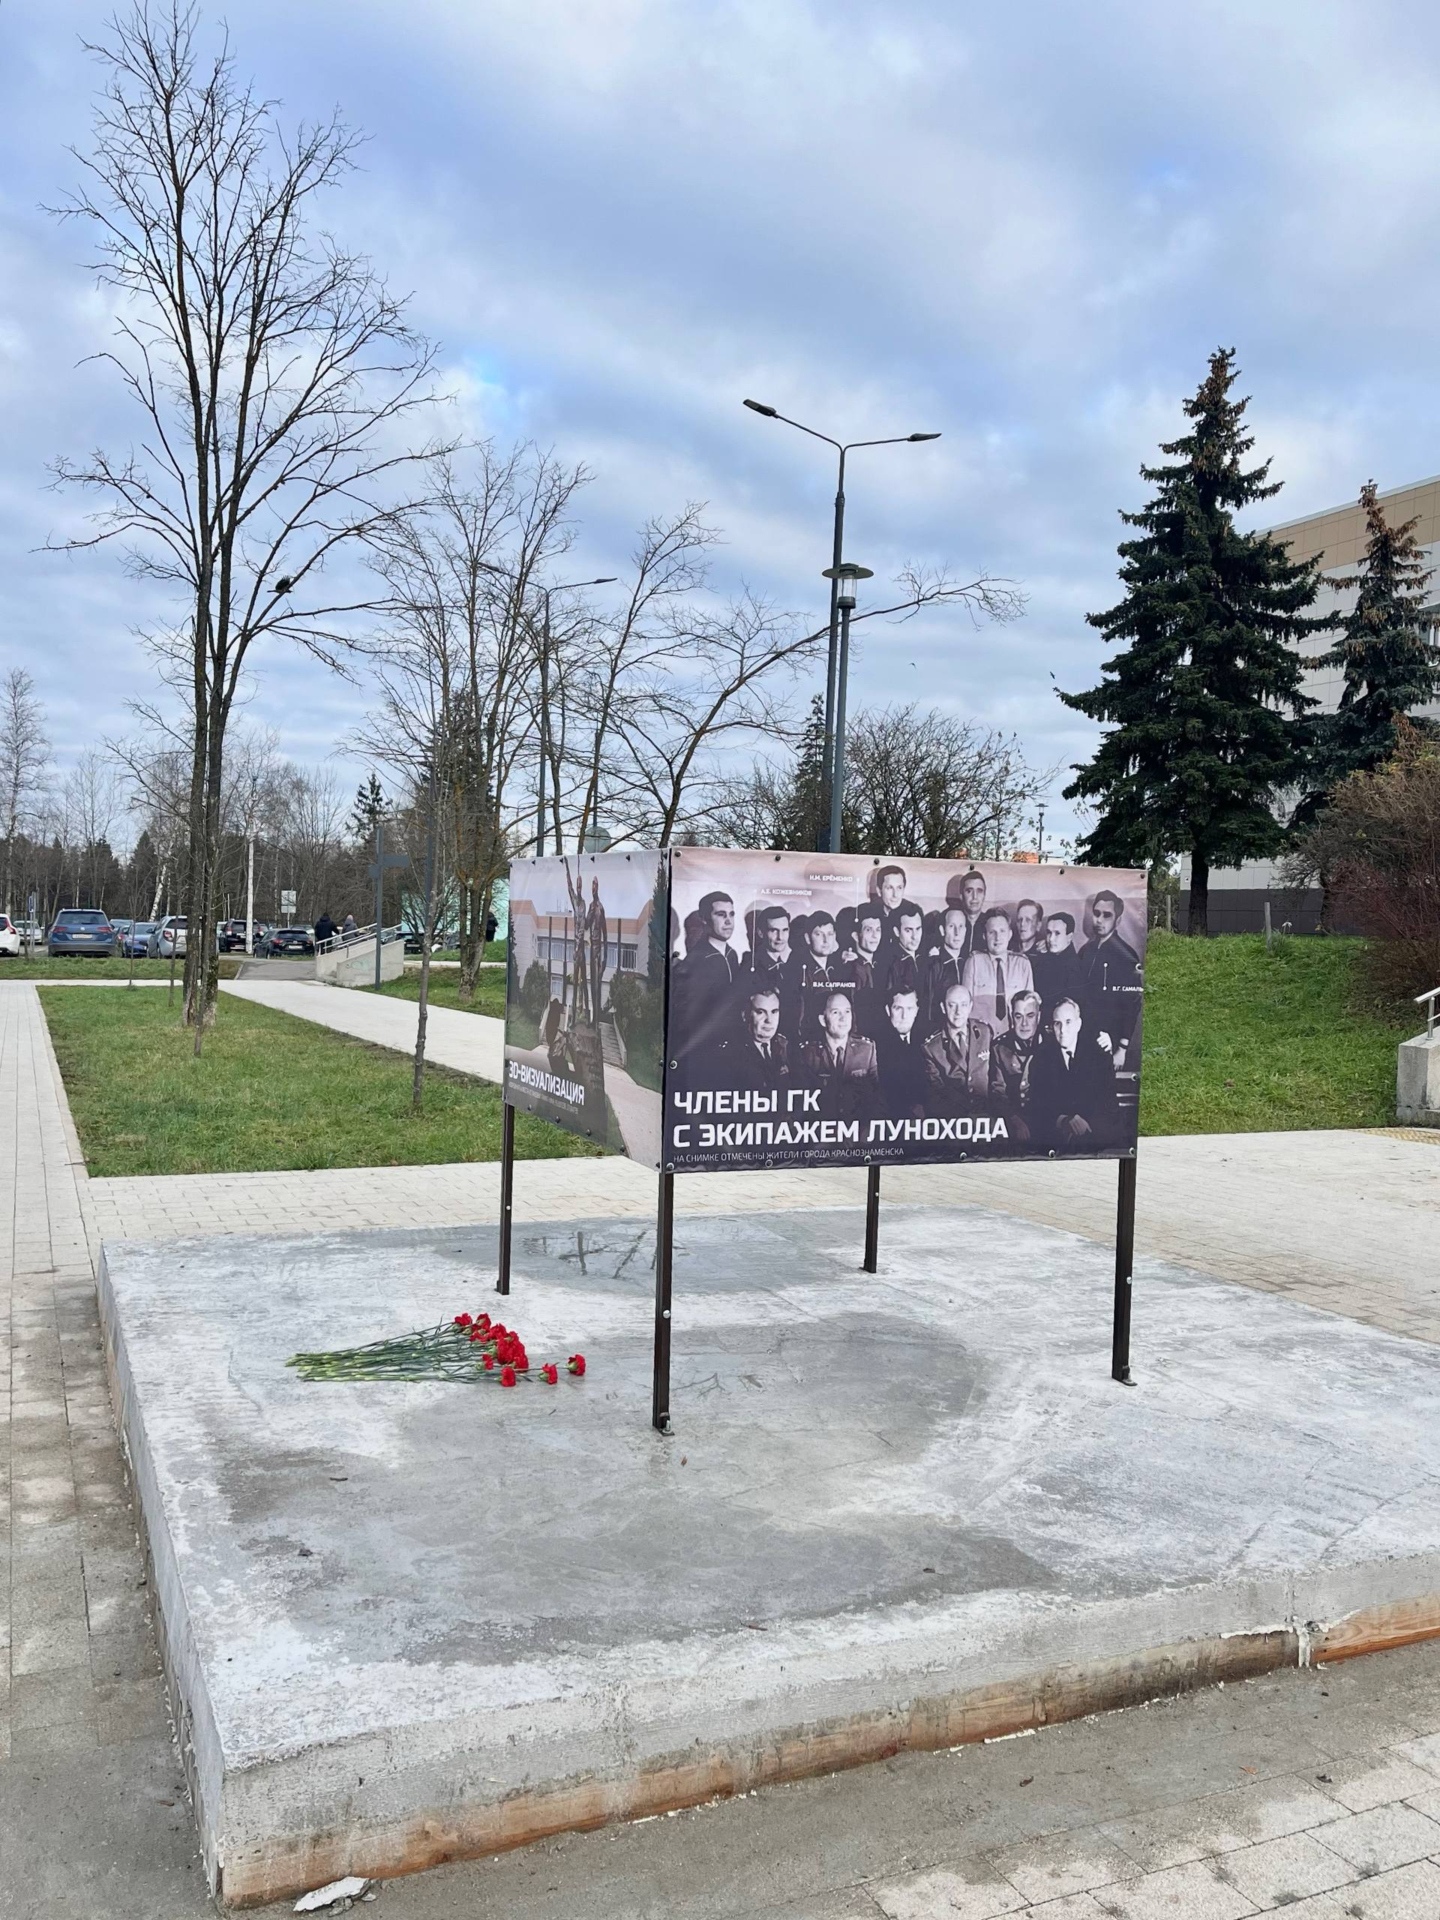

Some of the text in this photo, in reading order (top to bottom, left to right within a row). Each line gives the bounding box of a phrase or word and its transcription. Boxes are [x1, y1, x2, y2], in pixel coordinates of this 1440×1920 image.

[508, 1060, 585, 1106] 3D-ВИЗУАЛИЗАЦИЯ
[674, 1089, 821, 1114] ЧЛЕНЫ ГК
[673, 1117, 1009, 1148] С ЭКИПАЖЕМ ЛУНОХОДА
[673, 1147, 905, 1163] НА СНИМКЕ ОТМЕЧЕНЫ ЖИТЕЛИ ГОРОДА КРАСНОЗНАМЕНСКА
